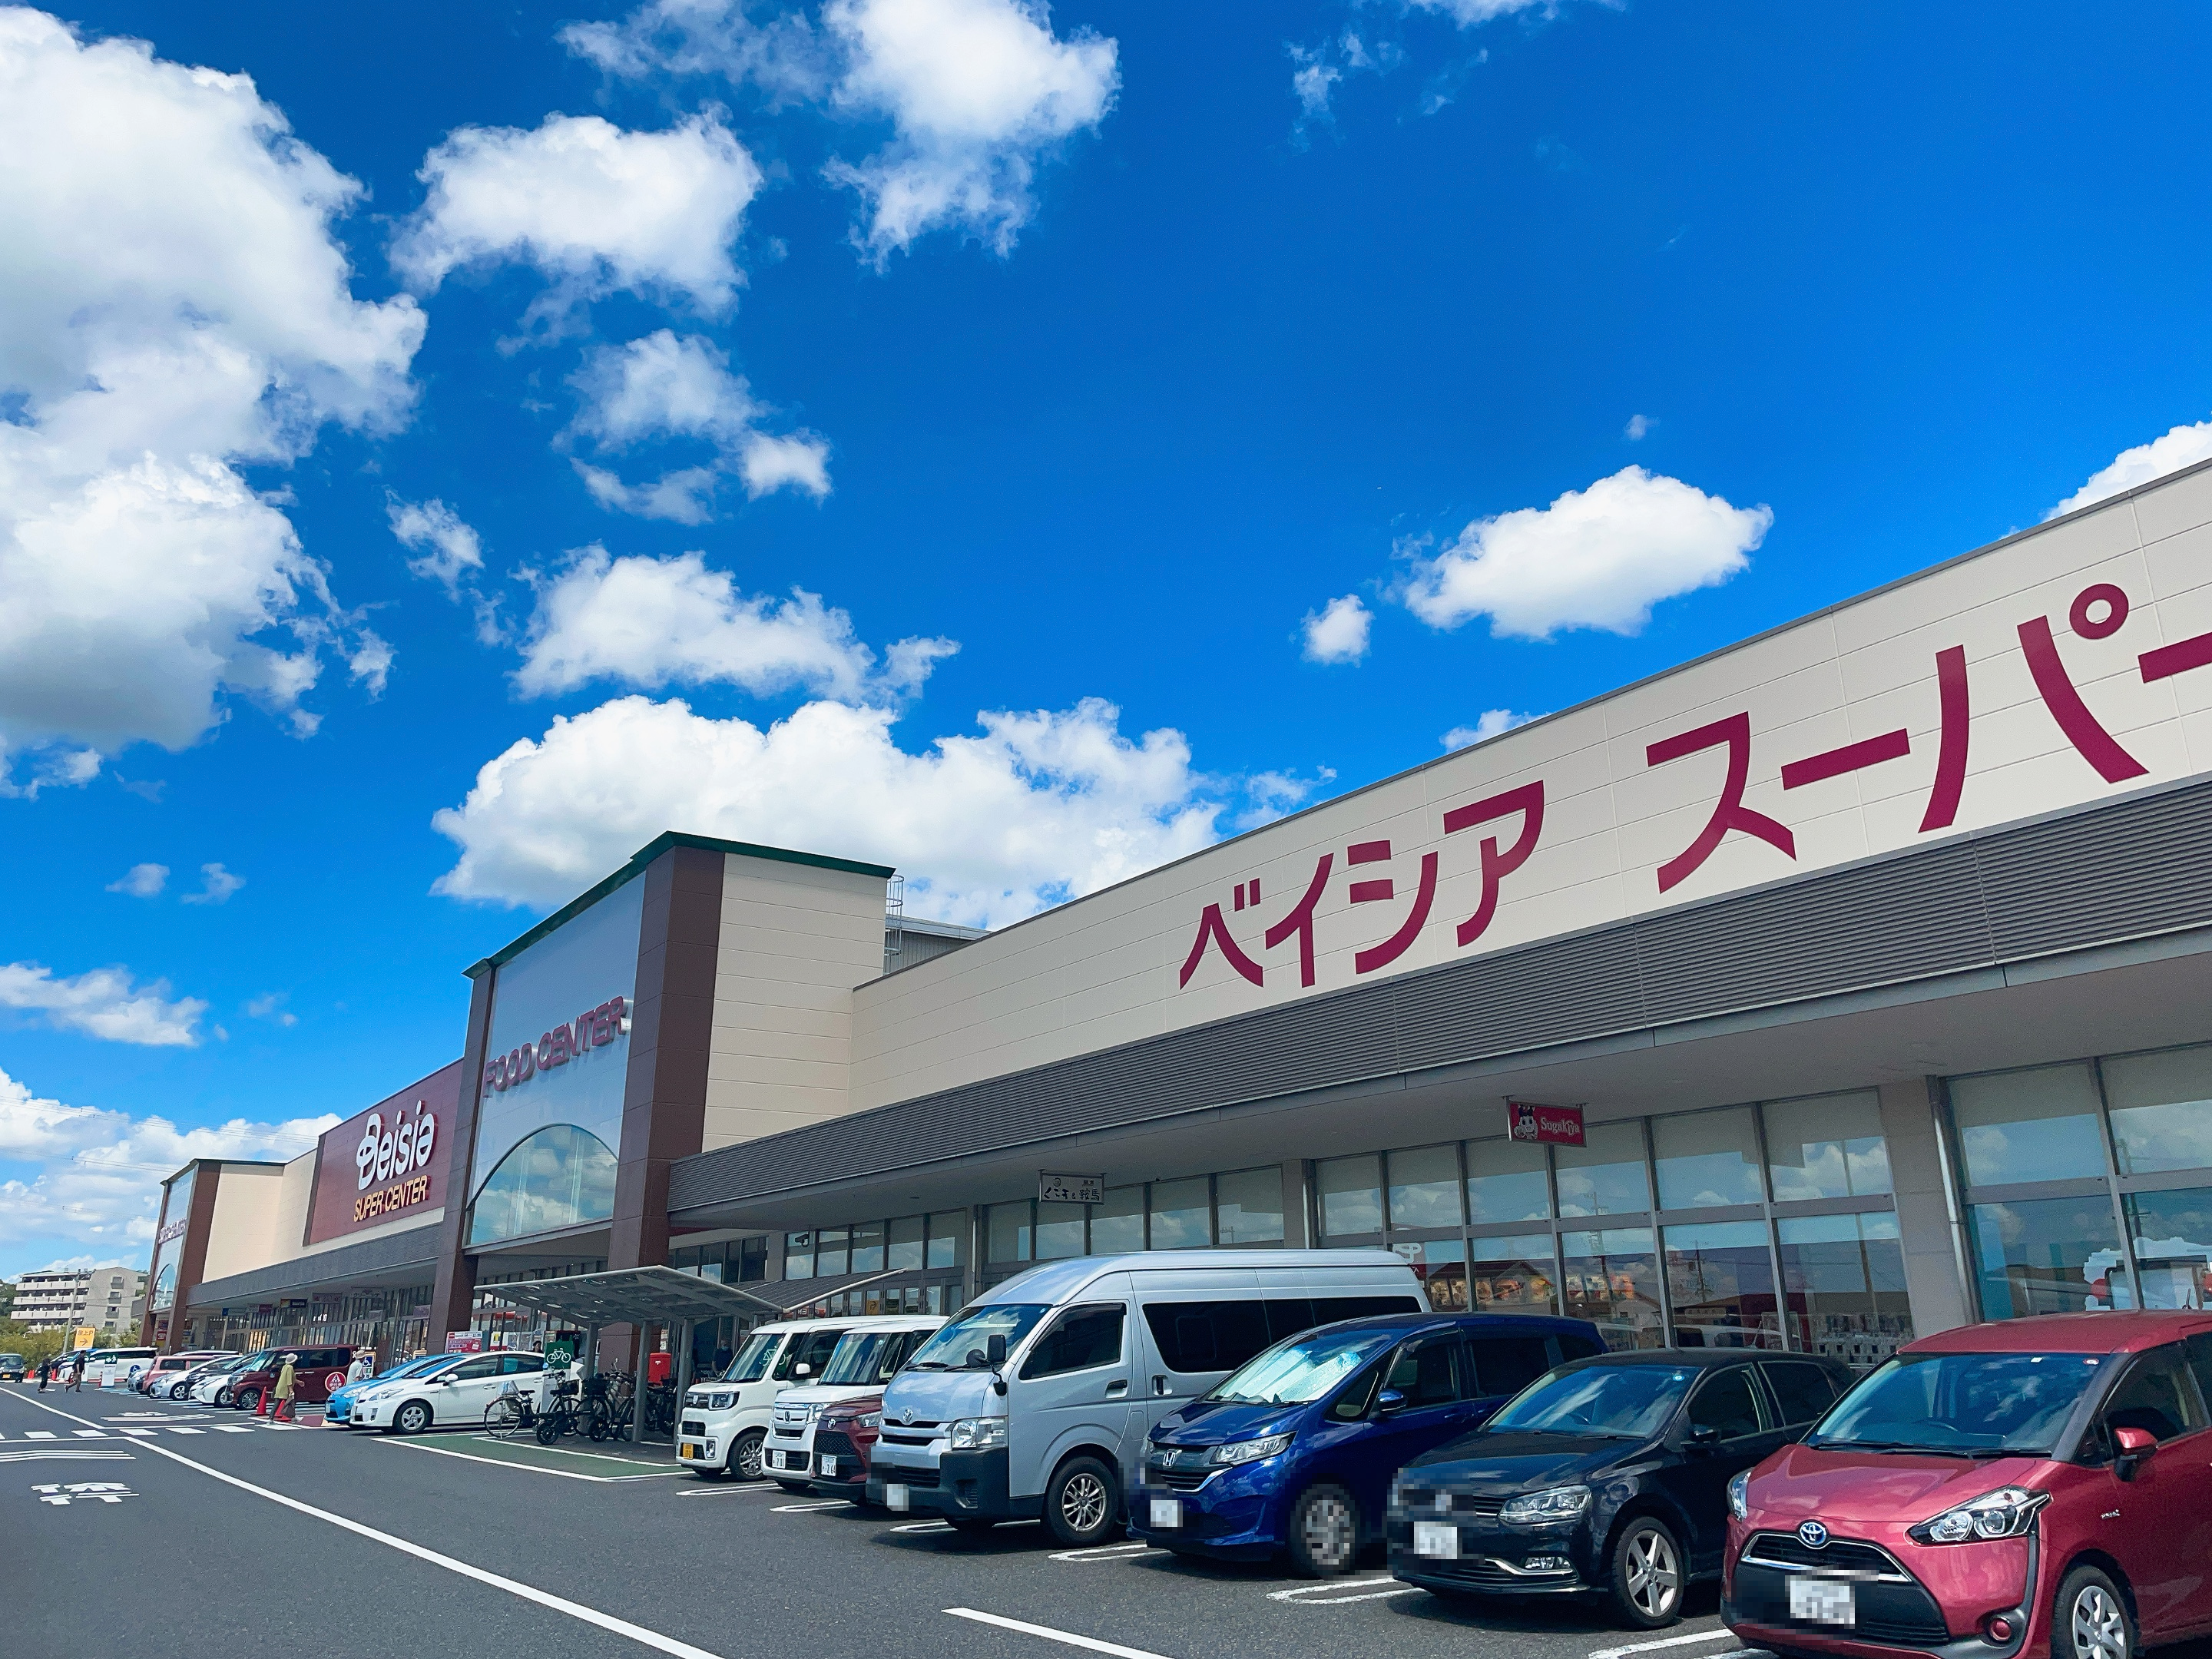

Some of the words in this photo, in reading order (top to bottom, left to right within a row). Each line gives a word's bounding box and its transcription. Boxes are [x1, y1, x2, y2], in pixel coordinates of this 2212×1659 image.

[1180, 780, 1545, 990] ベイシア
[482, 1042, 535, 1098] FOOD
[537, 995, 626, 1071] CENTER
[356, 1099, 435, 1190] Beisia
[1541, 1116, 1580, 1137] Sugakiya
[353, 1190, 384, 1223] SUPER
[385, 1174, 429, 1213] CENTER
